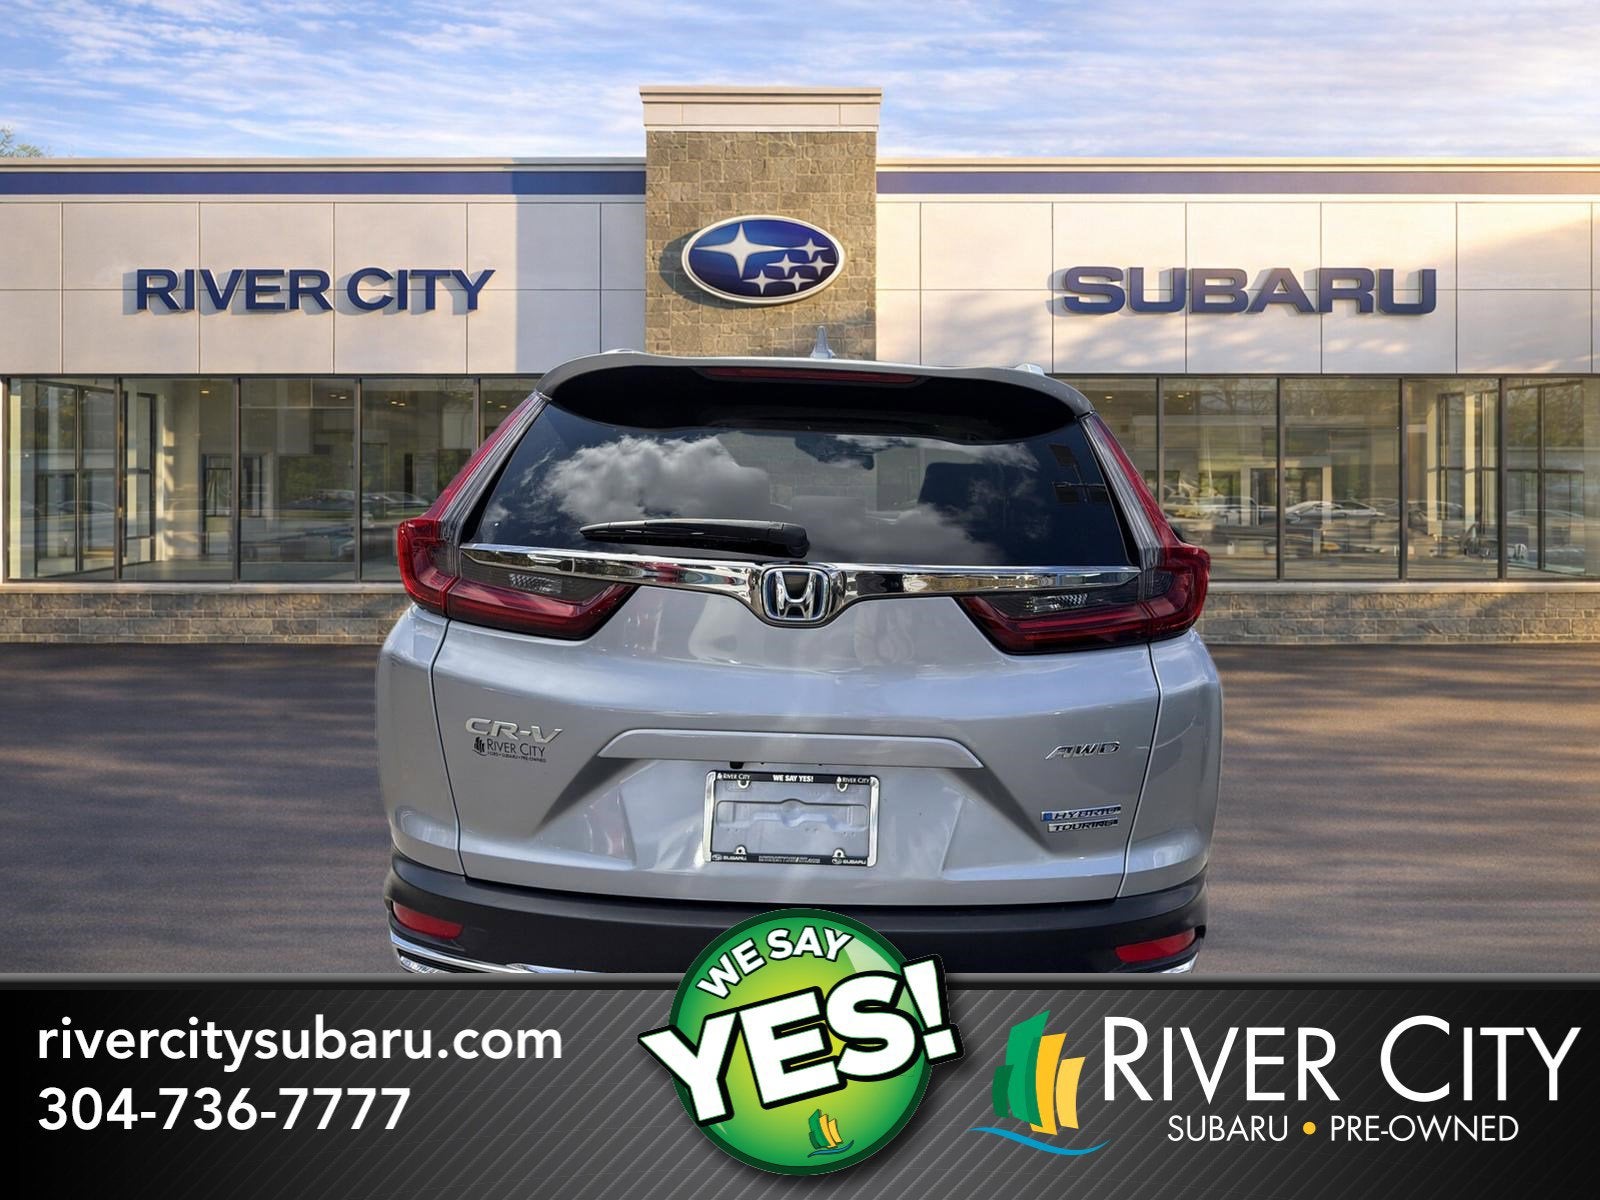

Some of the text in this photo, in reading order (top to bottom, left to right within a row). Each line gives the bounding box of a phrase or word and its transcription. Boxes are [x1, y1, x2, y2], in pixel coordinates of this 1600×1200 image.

[136, 267, 496, 311] RIVER CITY
[1062, 266, 1438, 315] SUBARU
[465, 717, 564, 744] CR-V
[487, 738, 546, 758] RIVER CITY
[1045, 740, 1121, 760] AWD
[772, 774, 814, 783] WE SAY YES!
